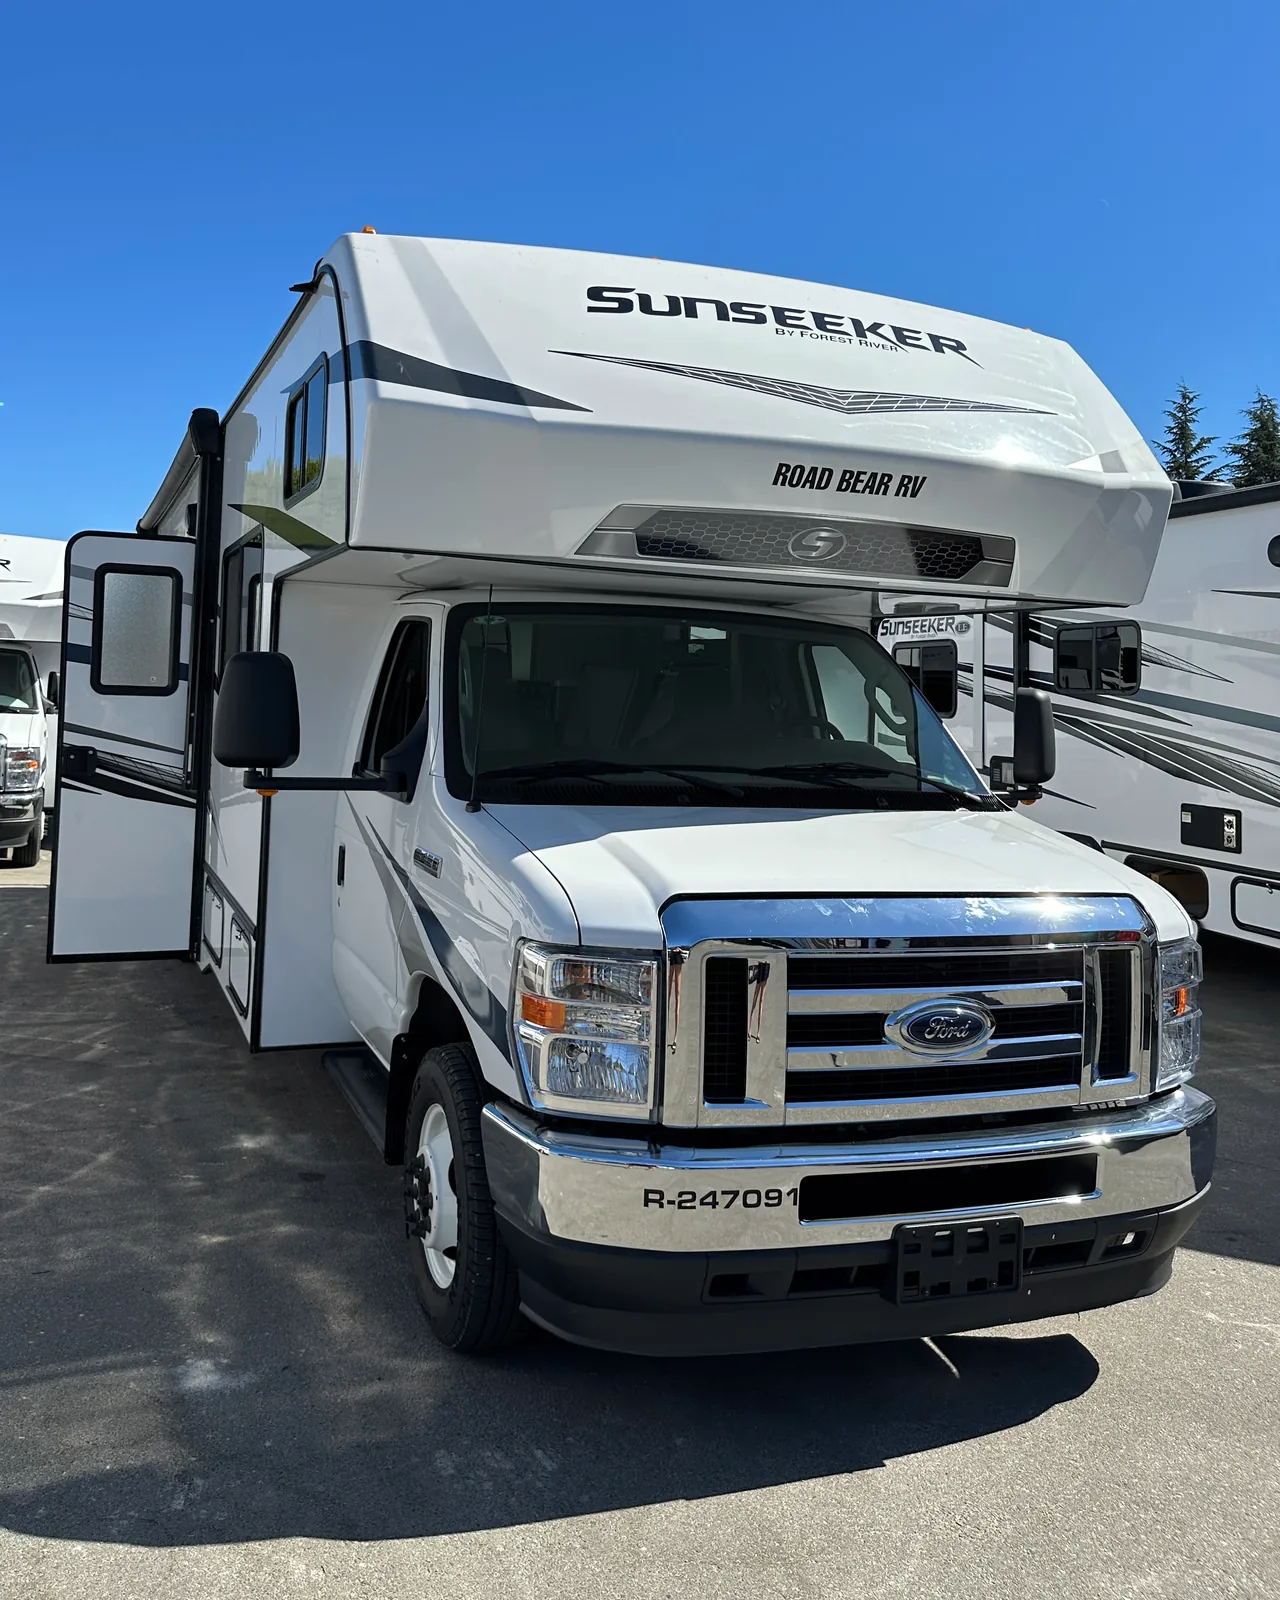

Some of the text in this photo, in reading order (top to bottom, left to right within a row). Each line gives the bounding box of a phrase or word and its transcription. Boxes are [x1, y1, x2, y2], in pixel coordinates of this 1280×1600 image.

[586, 285, 984, 369] SUNSEEKER
[772, 462, 928, 499] ROAD BEAR RV
[880, 616, 956, 637] SUNSEEKER
[924, 1015, 972, 1039] Ford
[643, 1187, 799, 1210] R-247091
